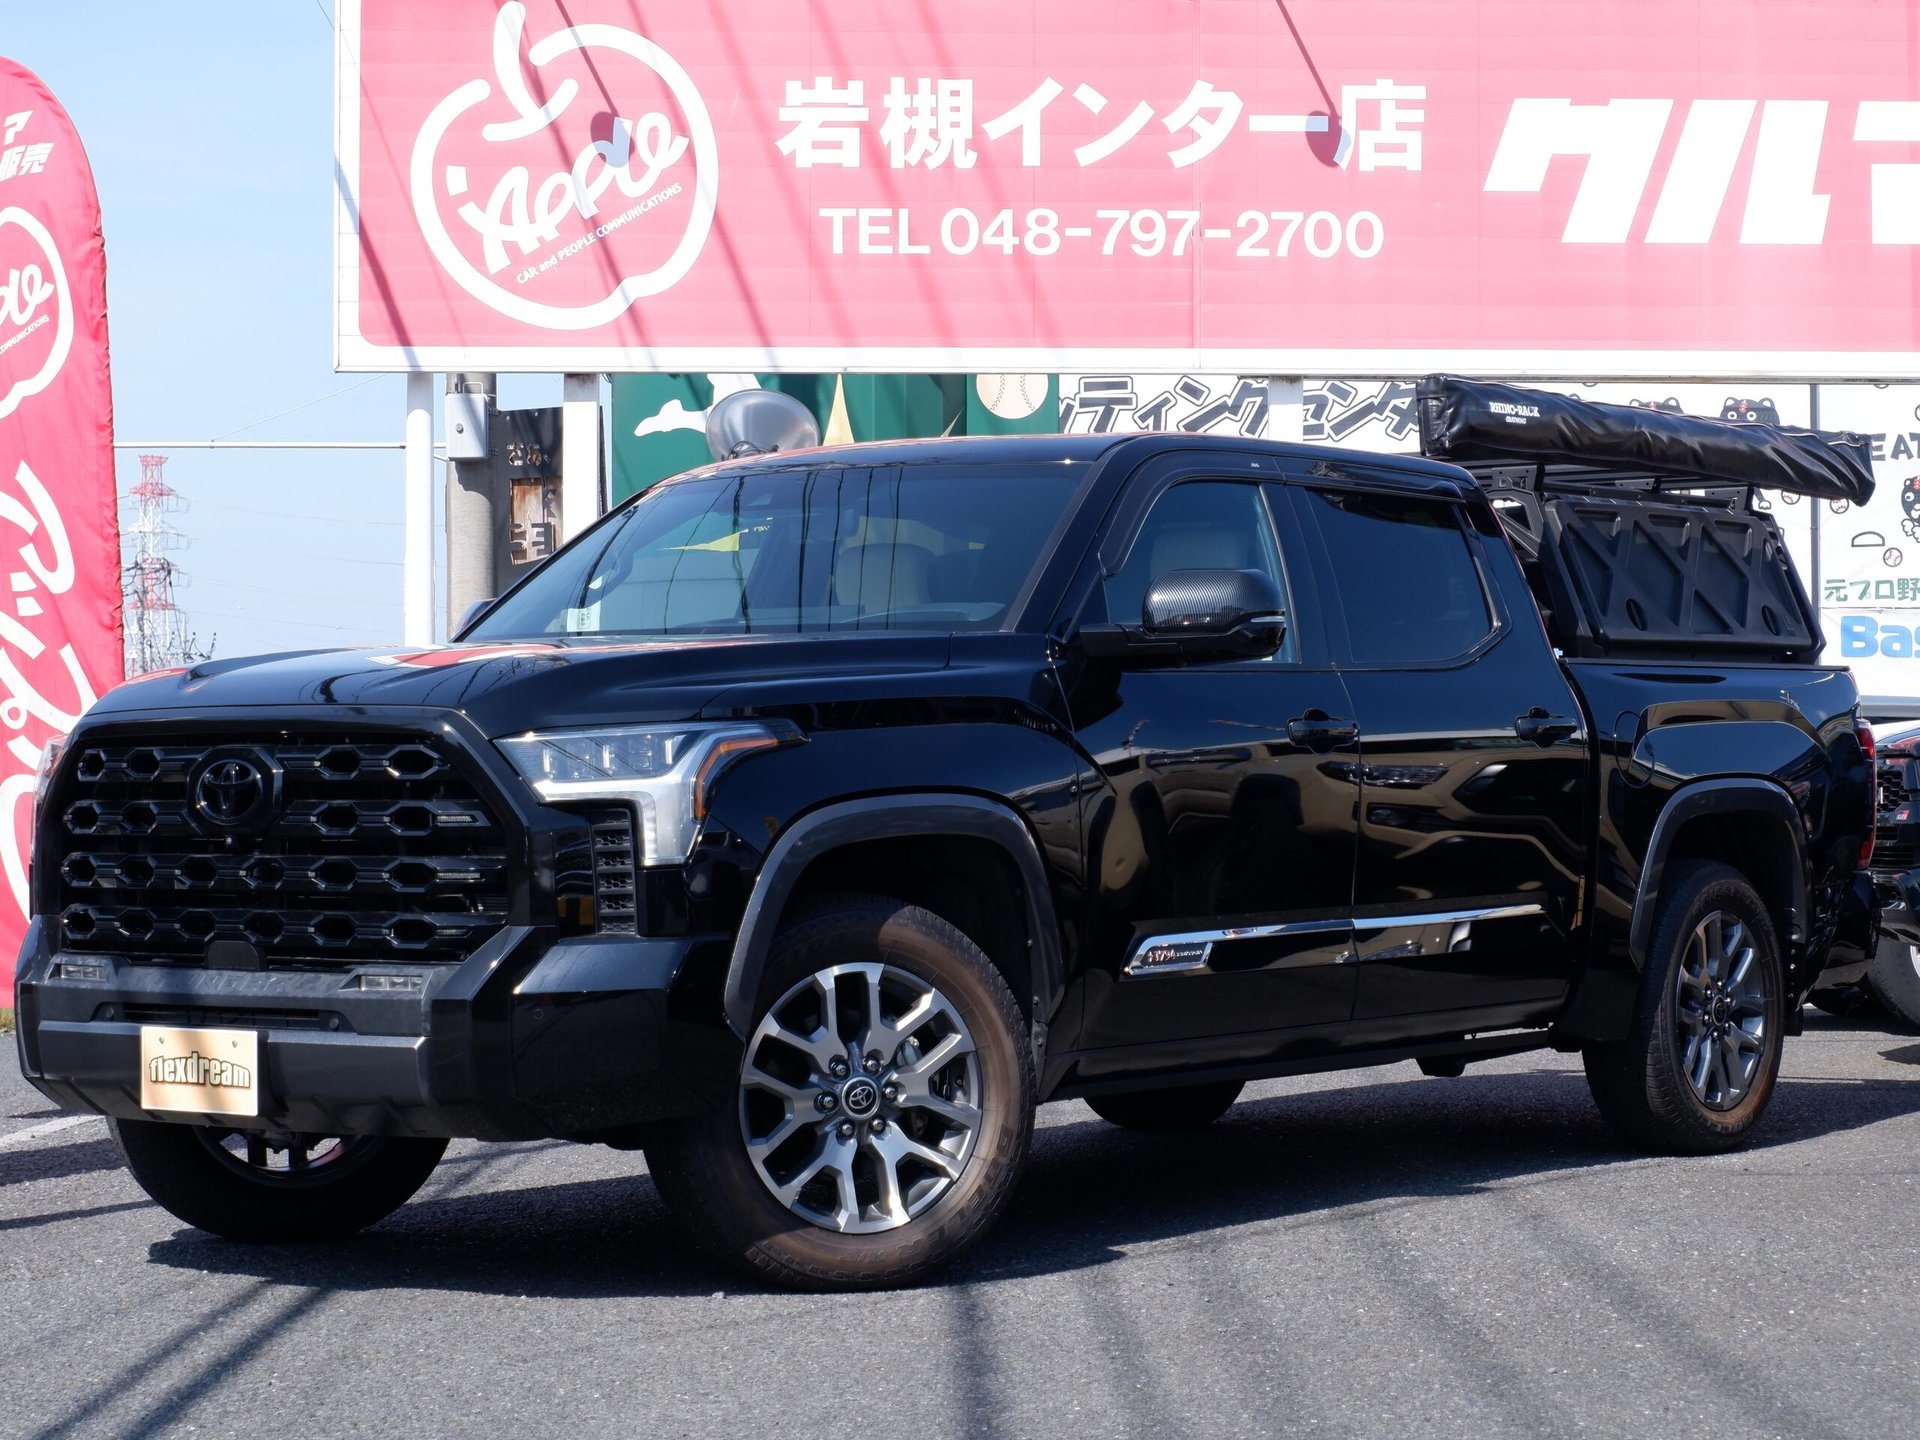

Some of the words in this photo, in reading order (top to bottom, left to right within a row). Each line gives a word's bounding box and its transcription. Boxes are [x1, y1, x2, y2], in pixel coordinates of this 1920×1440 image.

[775, 75, 1428, 172] 岩槻インター店
[446, 112, 690, 275] Apple
[516, 261, 540, 284] CAR
[539, 254, 559, 272] and
[558, 231, 597, 262] PEOPLE
[596, 182, 682, 238] COMMUNICATIONS
[819, 207, 930, 255] TEL
[940, 207, 1385, 259] 048-797-2700
[1488, 401, 1540, 416] RHINO-RACK
[1841, 615, 1920, 658] Ba
[149, 1051, 251, 1088] flexdream
